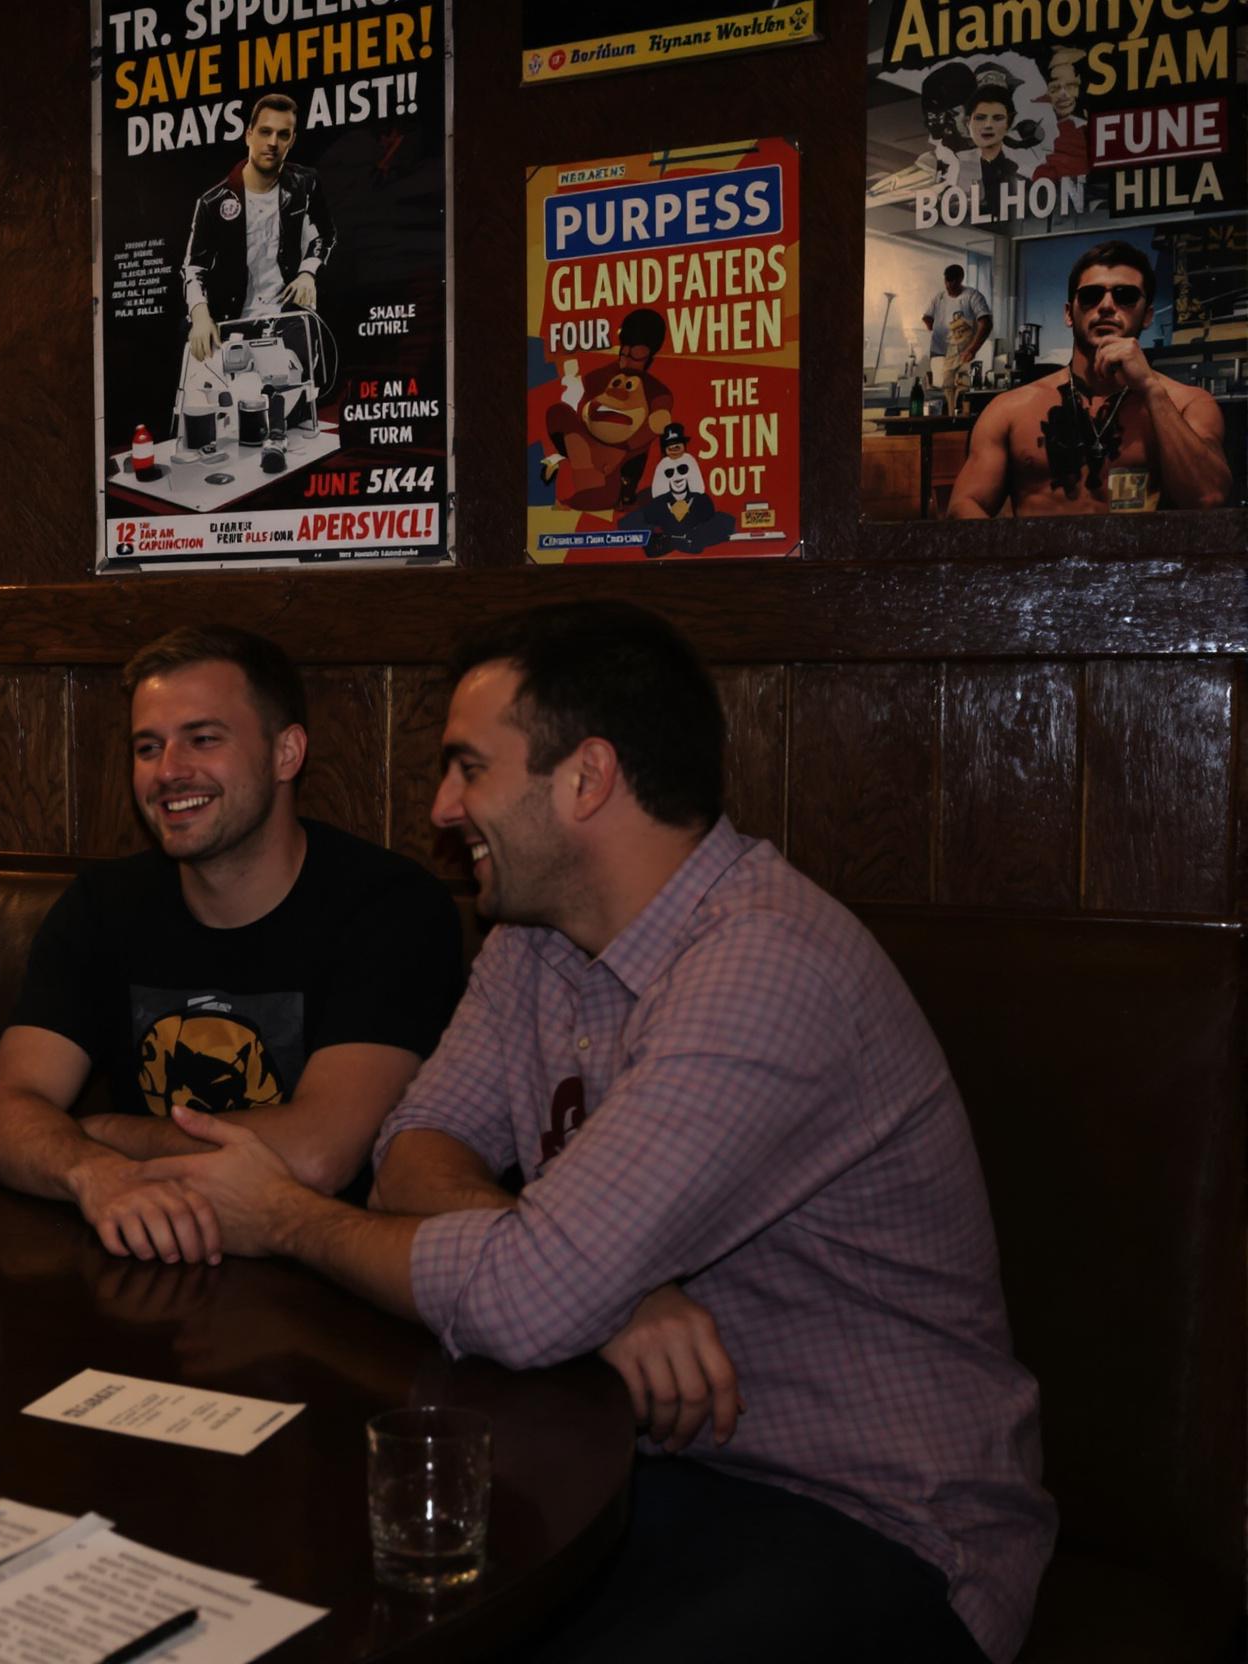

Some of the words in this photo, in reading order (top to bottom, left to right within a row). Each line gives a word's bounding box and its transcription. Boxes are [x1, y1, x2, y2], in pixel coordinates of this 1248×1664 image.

[109, 8, 172, 54] TR.
[114, 44, 222, 109] SAVE
[238, 6, 433, 90] IMFHER!
[1086, 26, 1229, 96] STAM
[127, 100, 245, 156] DRAYS
[306, 71, 418, 129] AIST!!
[1095, 102, 1221, 158] FUNE
[1115, 161, 1224, 211] HILA
[556, 180, 770, 251] PURPESS
[551, 244, 787, 312] GLANDFATERS
[550, 318, 610, 353] FOUR
[667, 298, 782, 354] WHEN
[383, 380, 402, 397] AN
[407, 377, 418, 396] A
[711, 377, 760, 408] THE
[698, 412, 779, 460] STIN
[304, 471, 360, 498] JUNE
[366, 466, 434, 494] 5K44
[709, 465, 766, 497] OUT
[116, 522, 136, 542] 12
